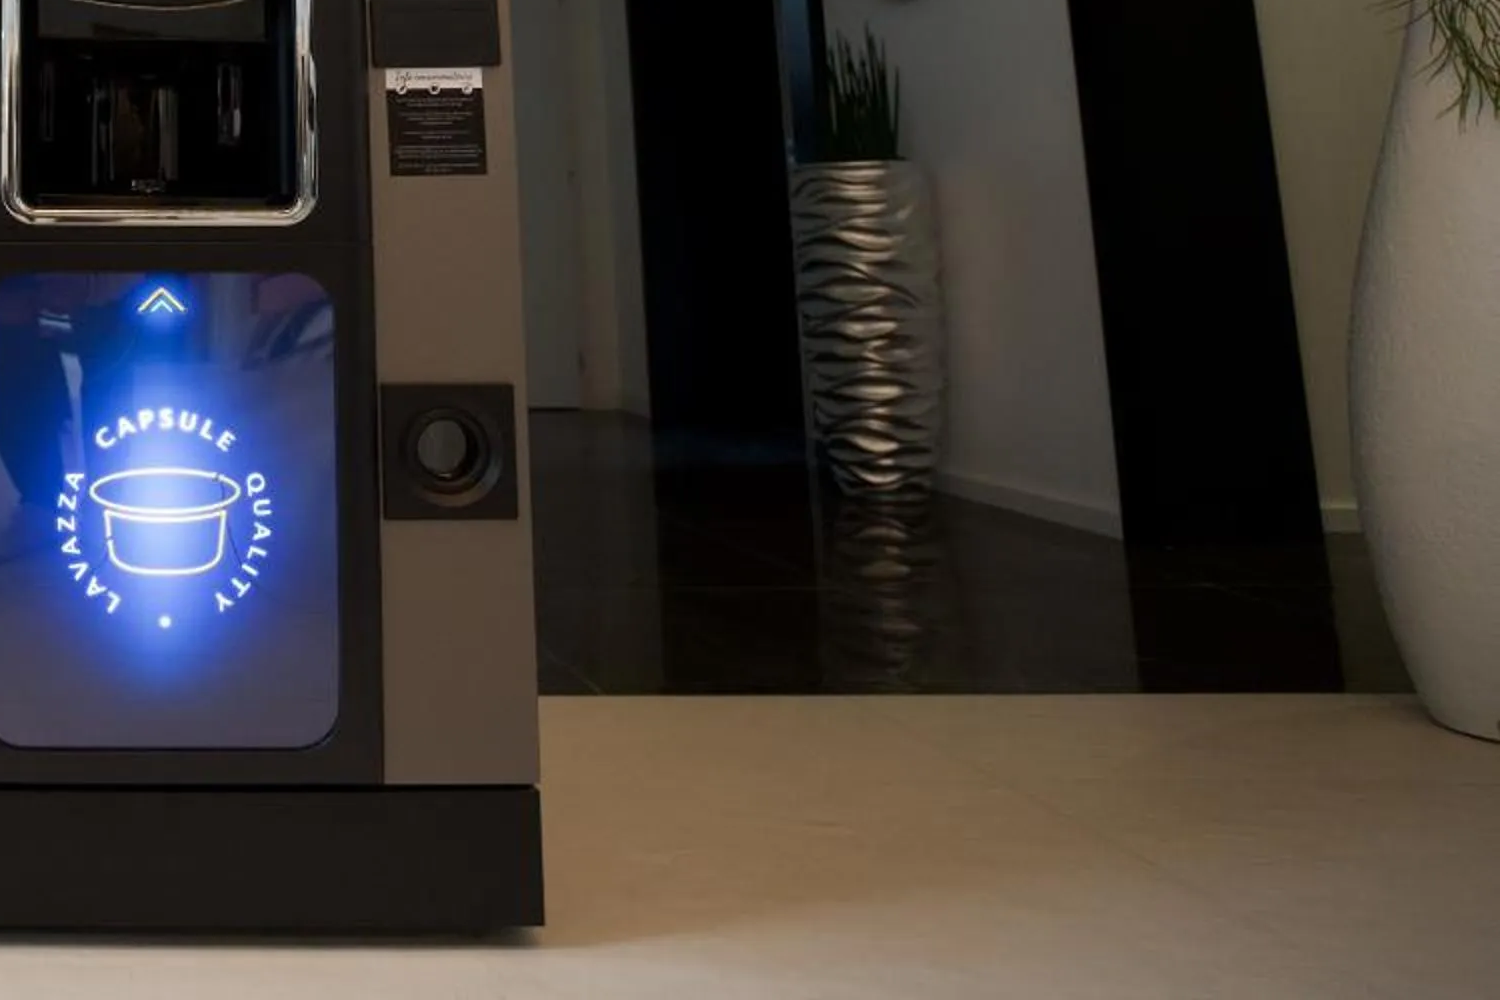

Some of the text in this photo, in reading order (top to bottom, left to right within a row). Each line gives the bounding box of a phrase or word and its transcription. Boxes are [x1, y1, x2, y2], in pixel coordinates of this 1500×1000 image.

[56, 406, 273, 614] LAVAZZA CAPSULE QUALITY
